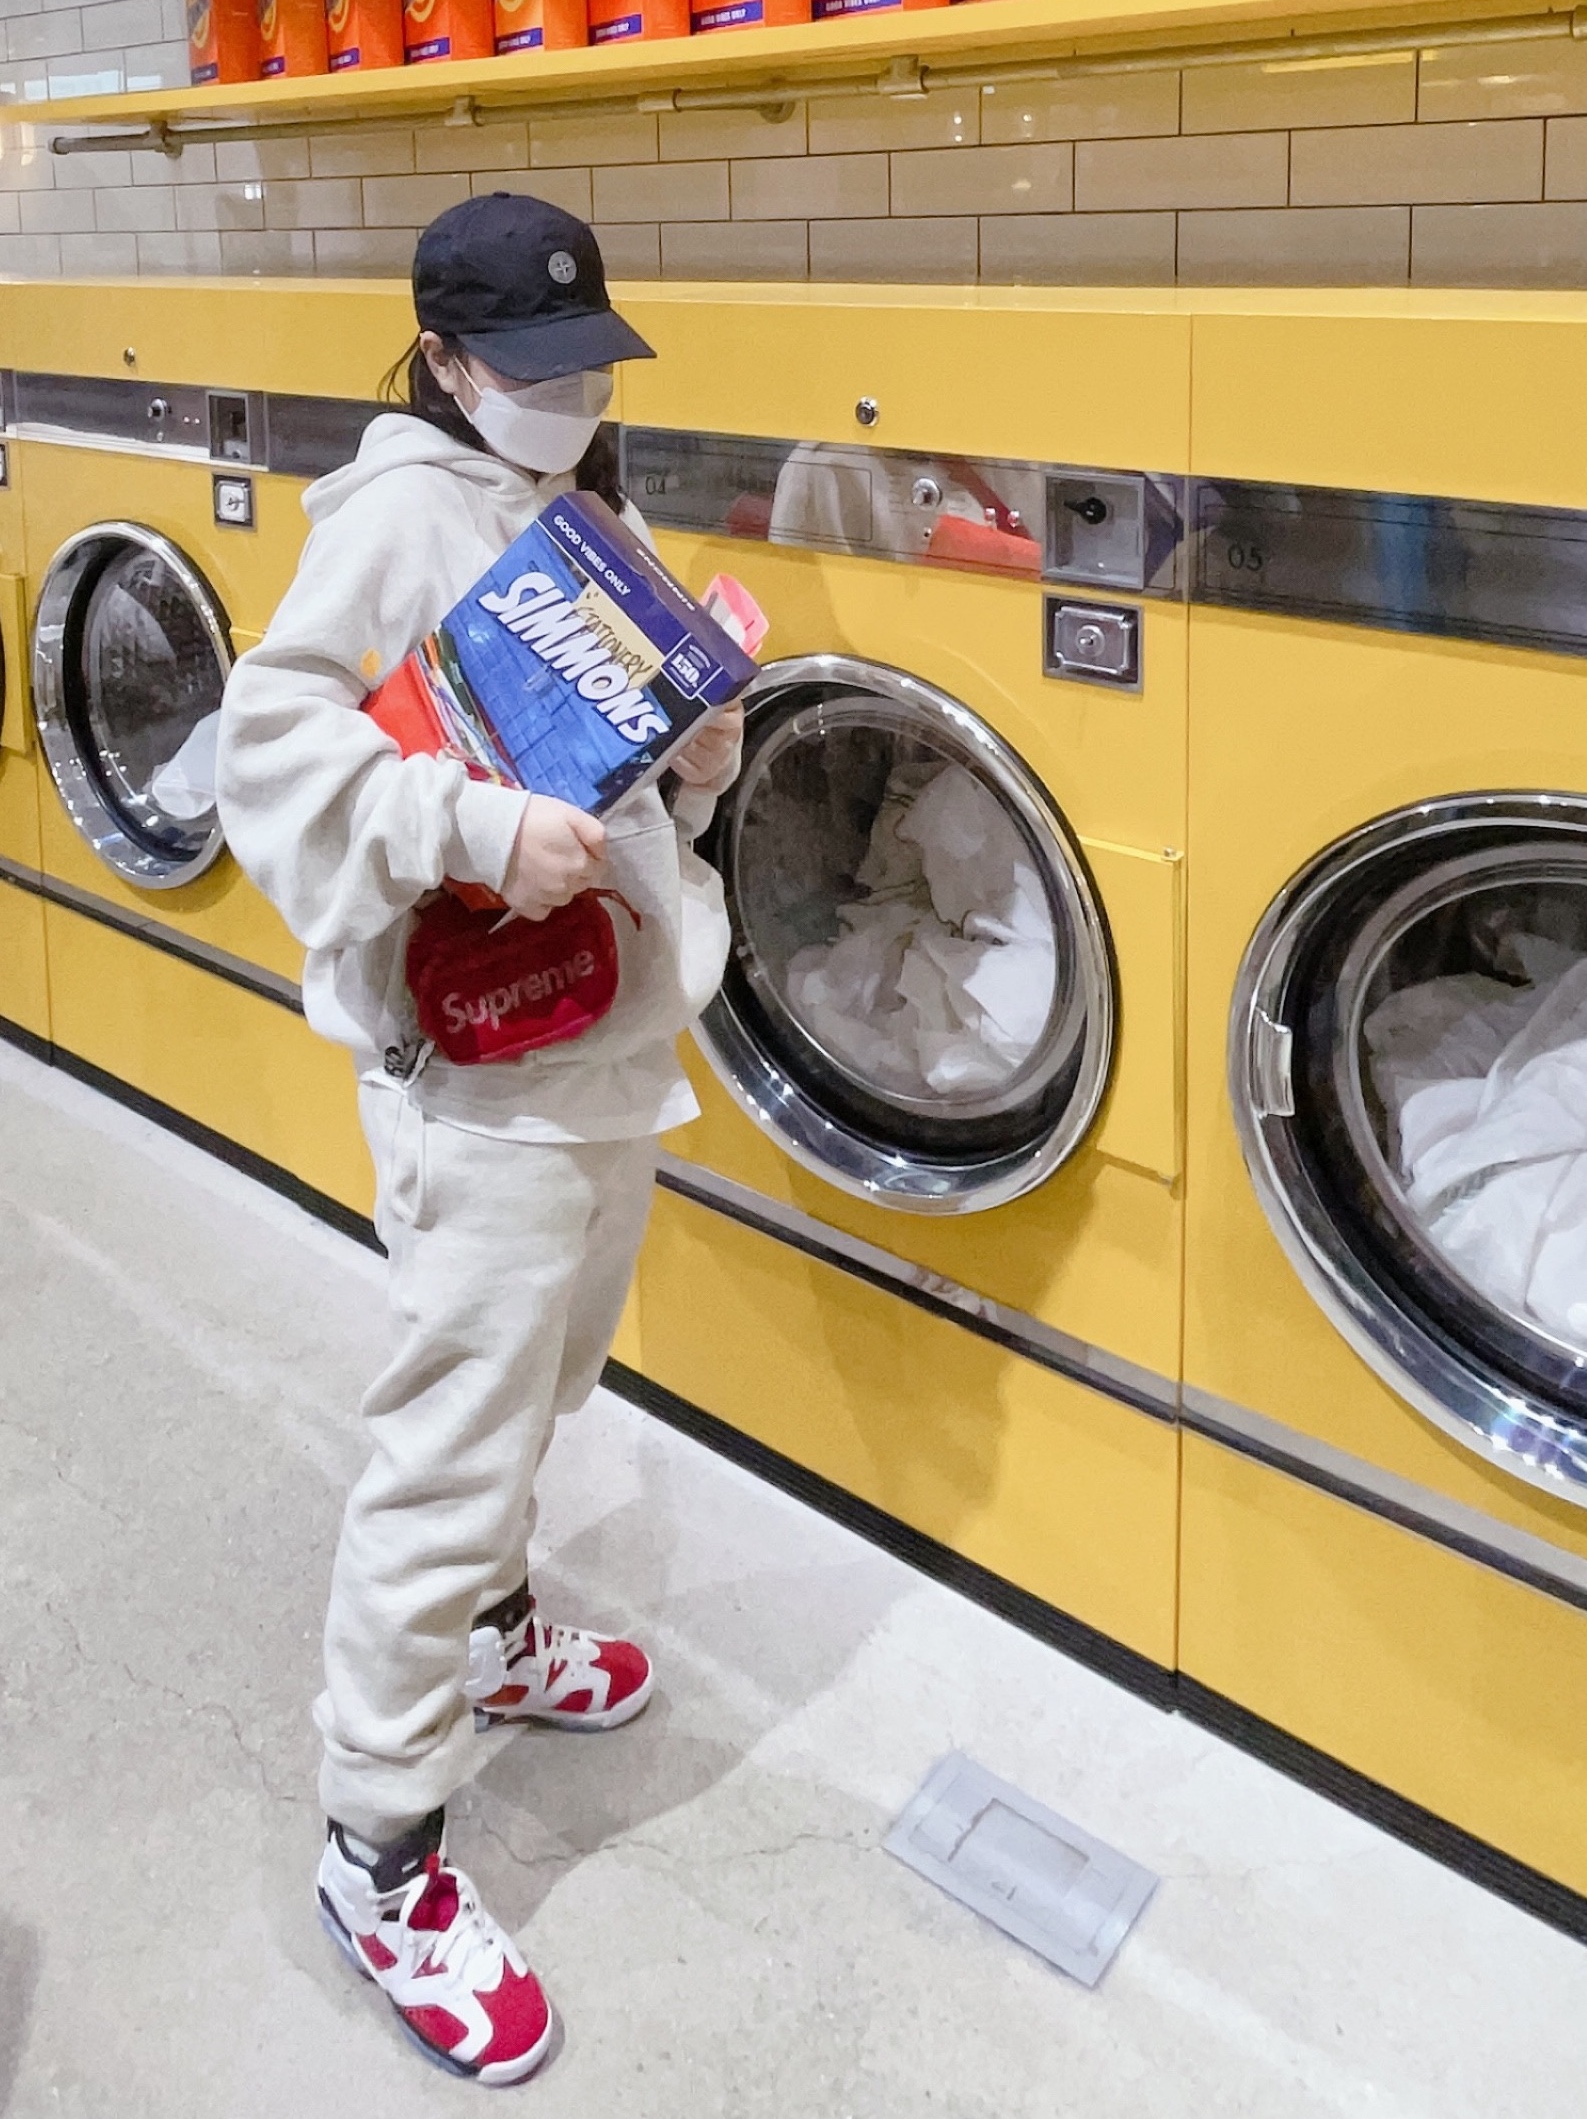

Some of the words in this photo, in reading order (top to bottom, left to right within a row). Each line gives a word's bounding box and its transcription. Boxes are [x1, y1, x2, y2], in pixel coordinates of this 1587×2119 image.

[553, 515, 582, 545] GOOD
[580, 541, 607, 573] VIBES
[604, 569, 631, 596] ONLY
[1227, 544, 1263, 572] 05
[478, 571, 670, 743] SIMMONS
[441, 950, 595, 1034] Supreme
